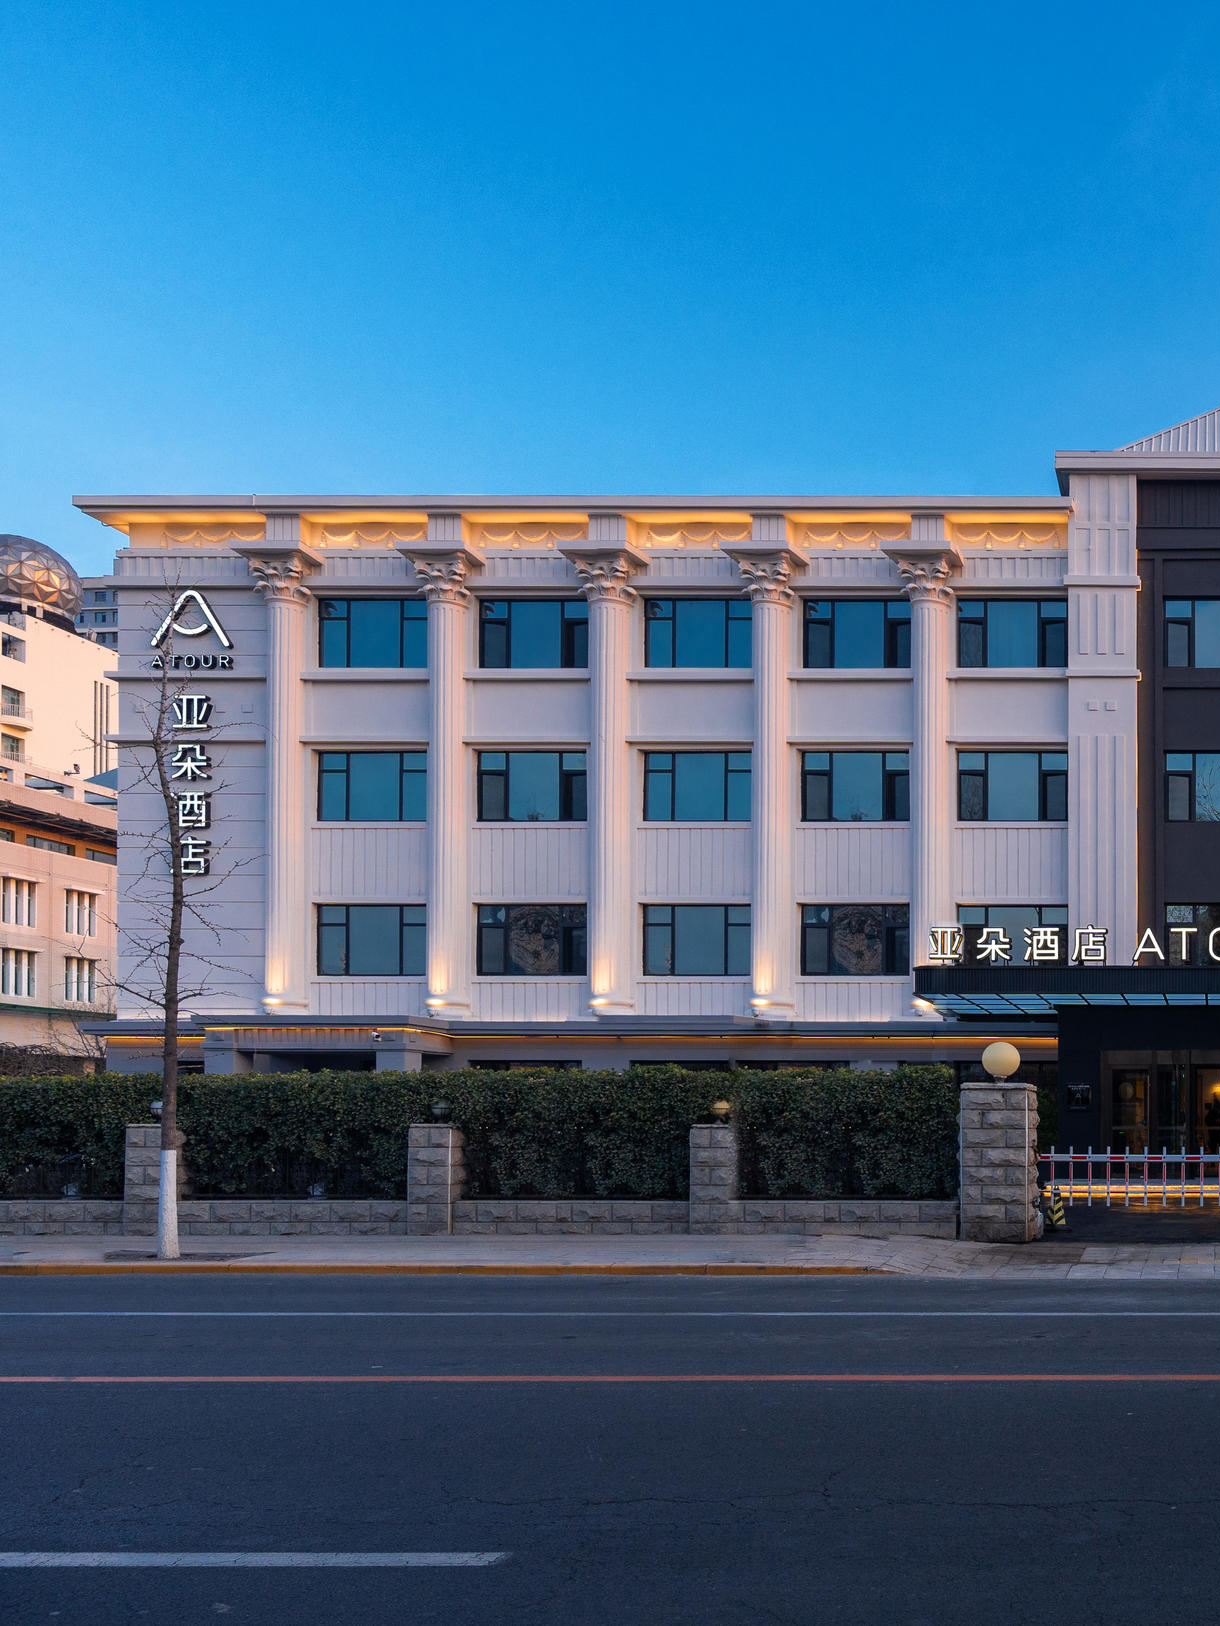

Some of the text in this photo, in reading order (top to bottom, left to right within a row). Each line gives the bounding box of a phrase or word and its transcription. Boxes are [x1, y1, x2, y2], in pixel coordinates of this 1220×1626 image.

[151, 654, 231, 668] ATOUR
[170, 694, 209, 875] 亚朵酒店
[928, 925, 1107, 962] 亚朵酒店
